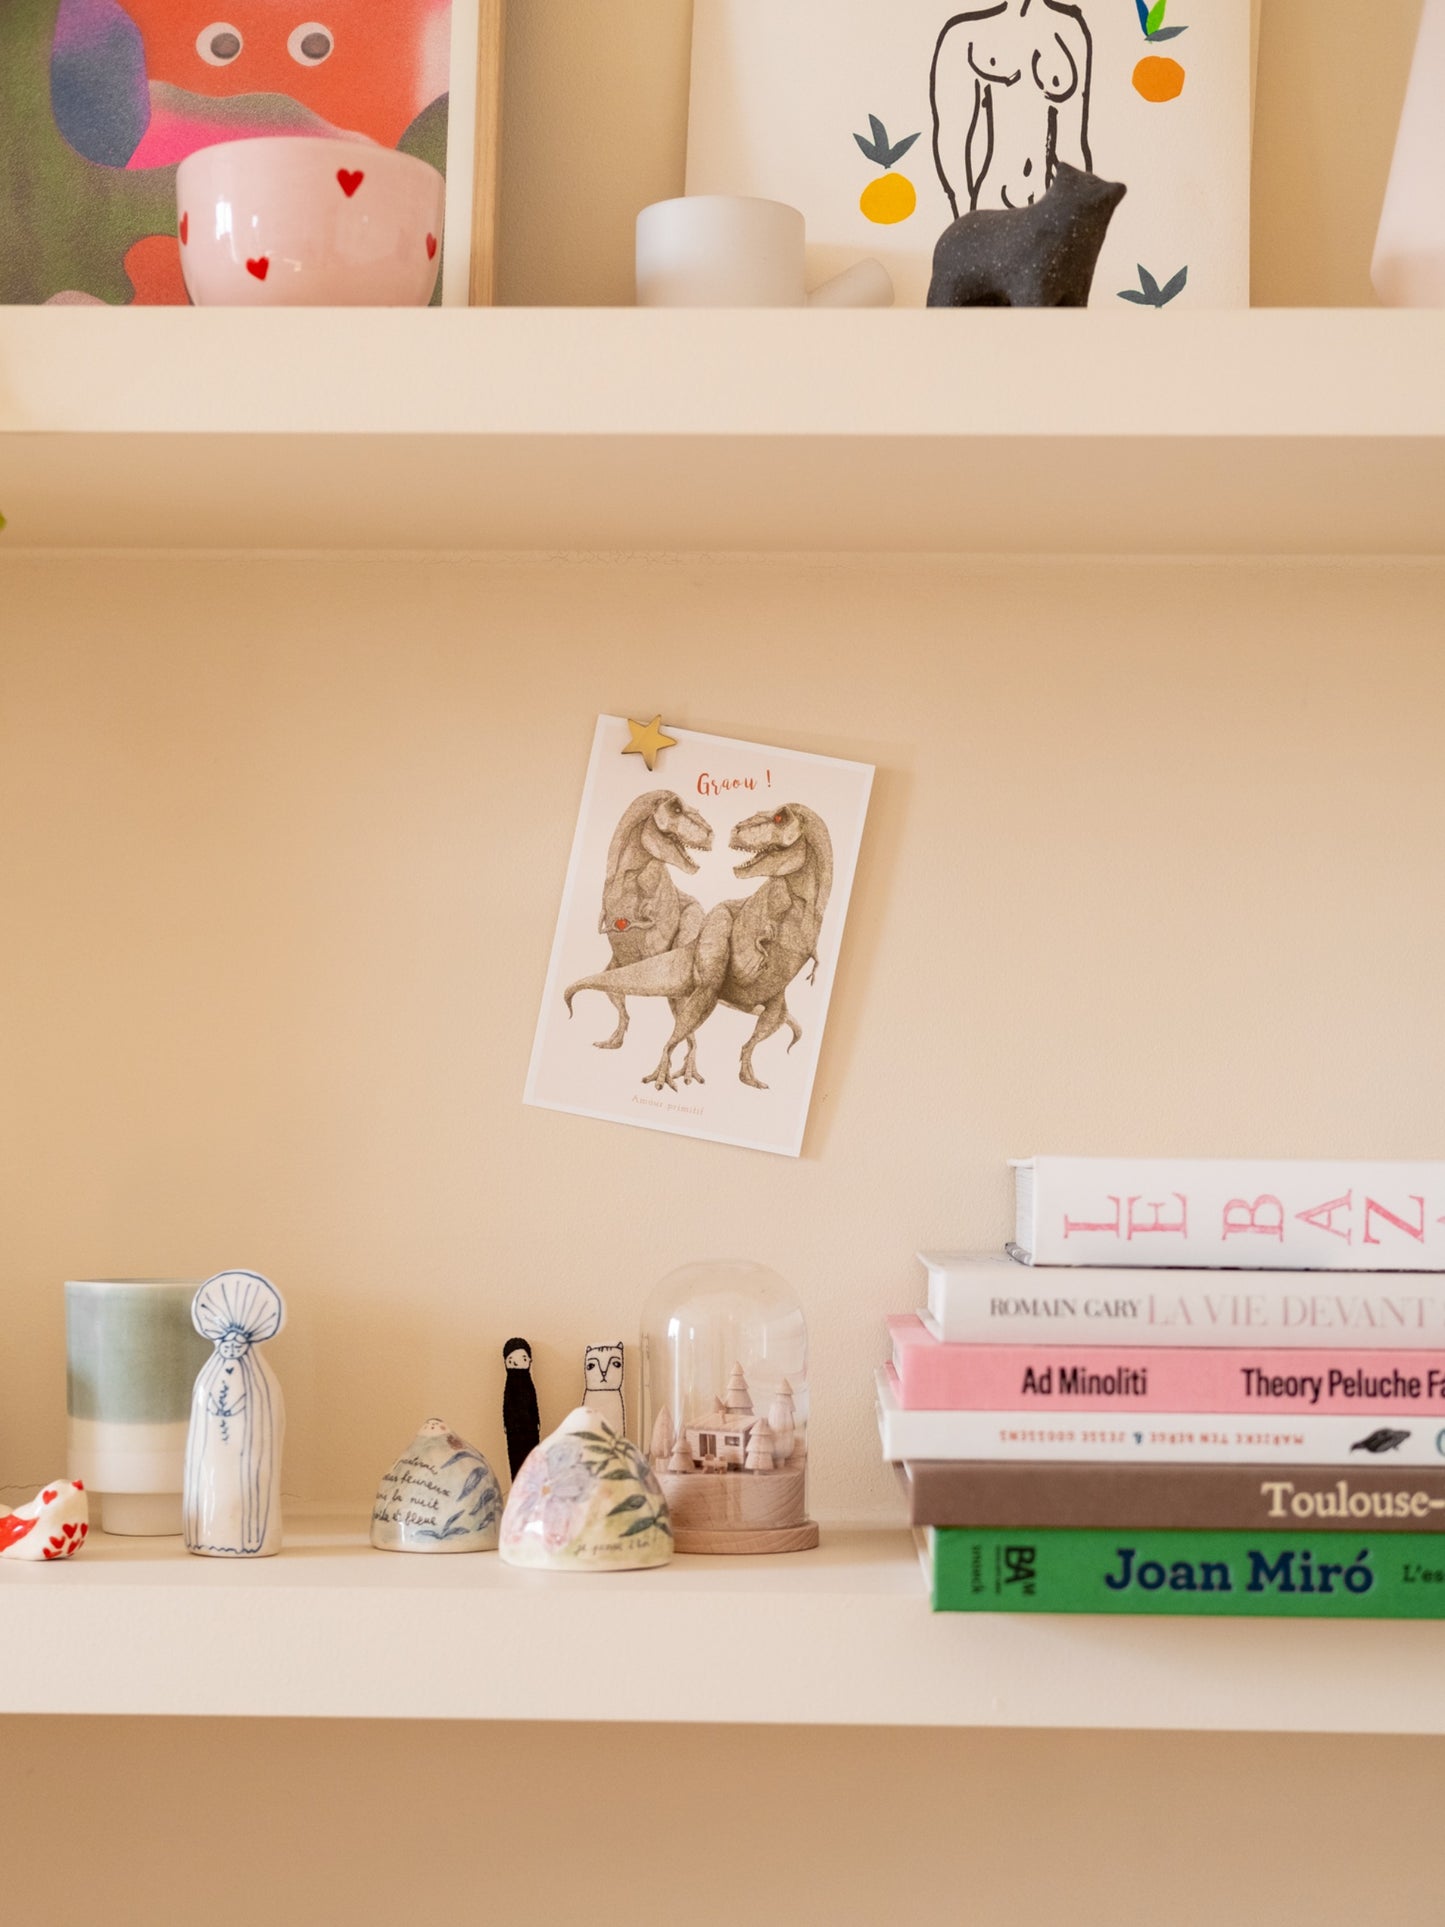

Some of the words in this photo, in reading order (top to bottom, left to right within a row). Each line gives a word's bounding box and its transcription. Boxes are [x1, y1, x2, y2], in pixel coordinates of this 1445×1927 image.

[696, 772, 758, 797] Graou
[1063, 1191, 1188, 1241] LE
[1221, 1188, 1445, 1245] BAZ
[989, 1297, 1077, 1318] ROMAIN
[1083, 1298, 1140, 1319] GARY
[1147, 1294, 1194, 1326] LA
[1201, 1294, 1268, 1327] VIE
[1281, 1295, 1434, 1329] DEVANT
[1021, 1366, 1052, 1395] Ad
[1058, 1366, 1148, 1396] Minoliti
[1240, 1367, 1322, 1405] Theory
[1327, 1368, 1421, 1399] Peluche
[1132, 1430, 1143, 1445] &
[1200, 1432, 1229, 1445] TEN
[1260, 1480, 1445, 1518] Toulouse-
[1104, 1548, 1232, 1590] Joan
[1245, 1548, 1374, 1594] Miró
